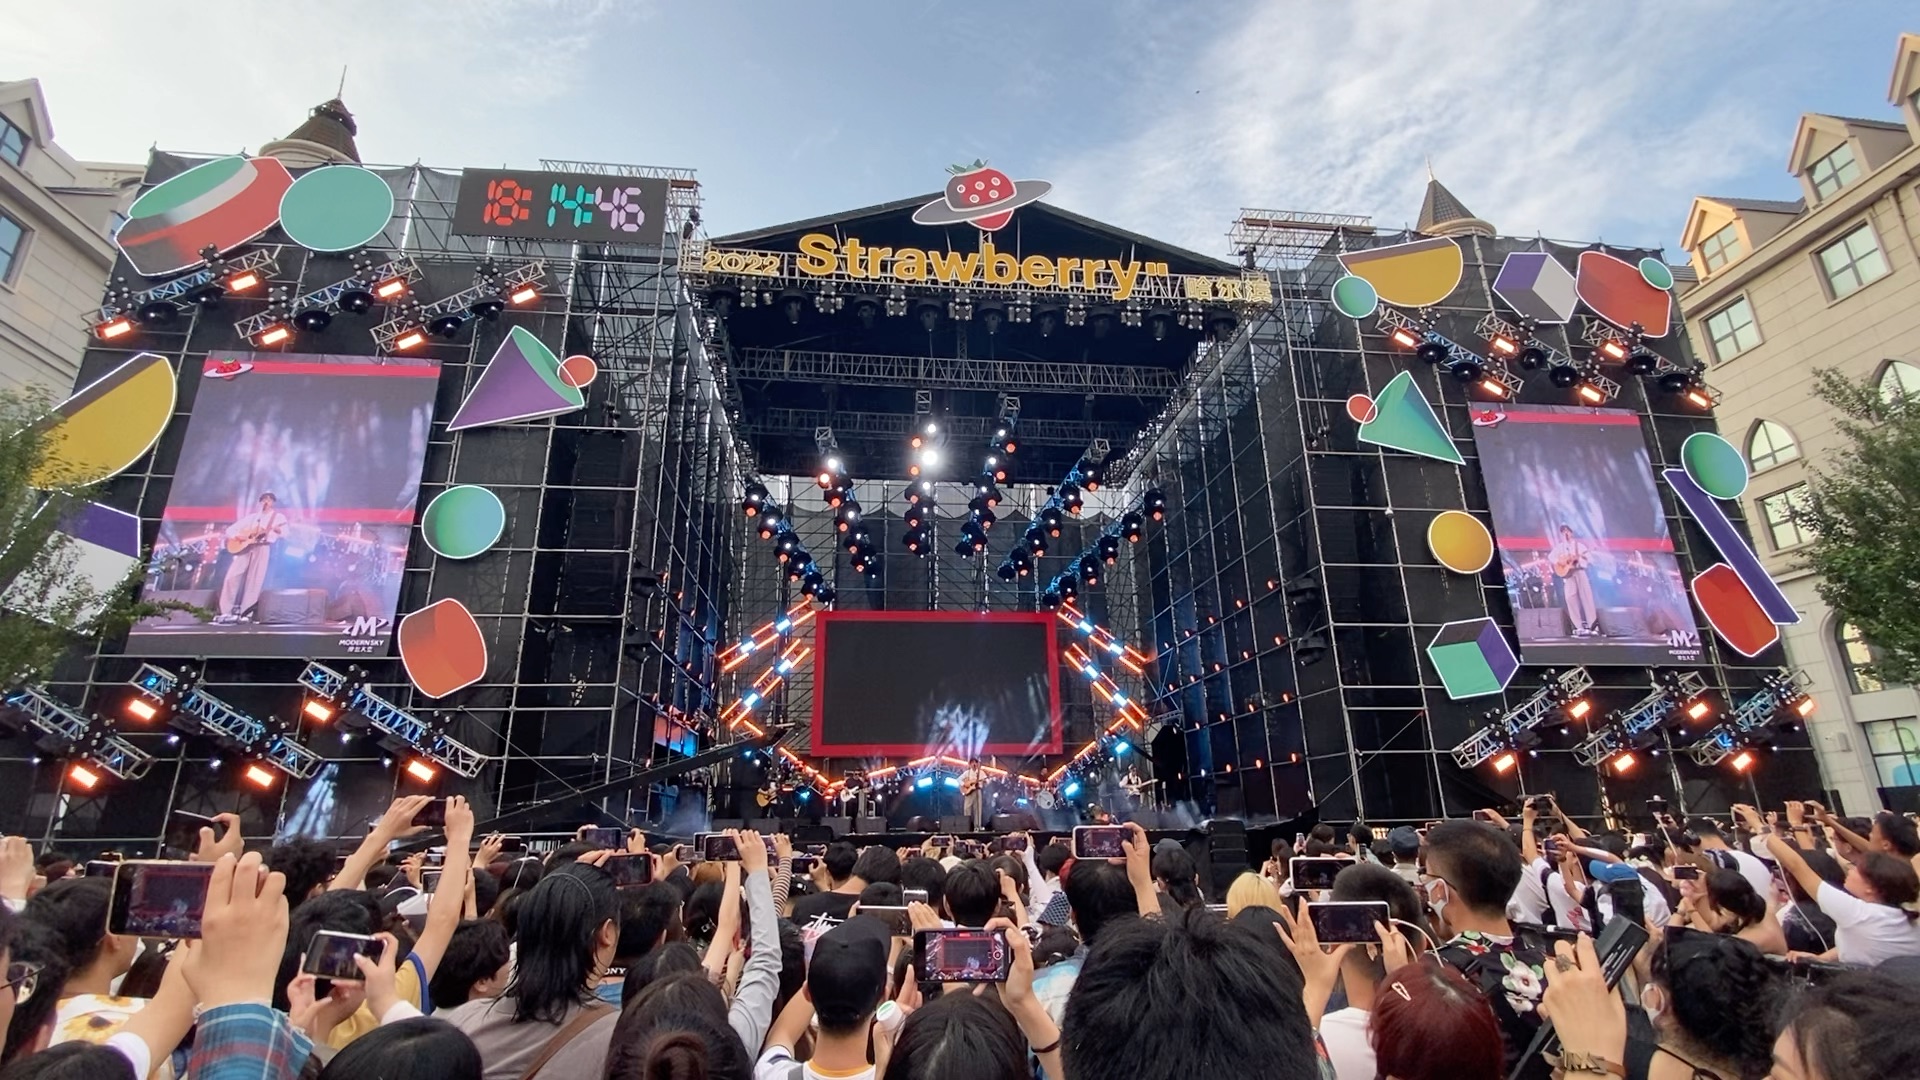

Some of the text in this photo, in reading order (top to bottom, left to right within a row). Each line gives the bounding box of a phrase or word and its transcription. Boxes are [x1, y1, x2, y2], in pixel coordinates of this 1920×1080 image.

[703, 250, 780, 277] 2022
[1185, 275, 1273, 304] 哈尔滨
